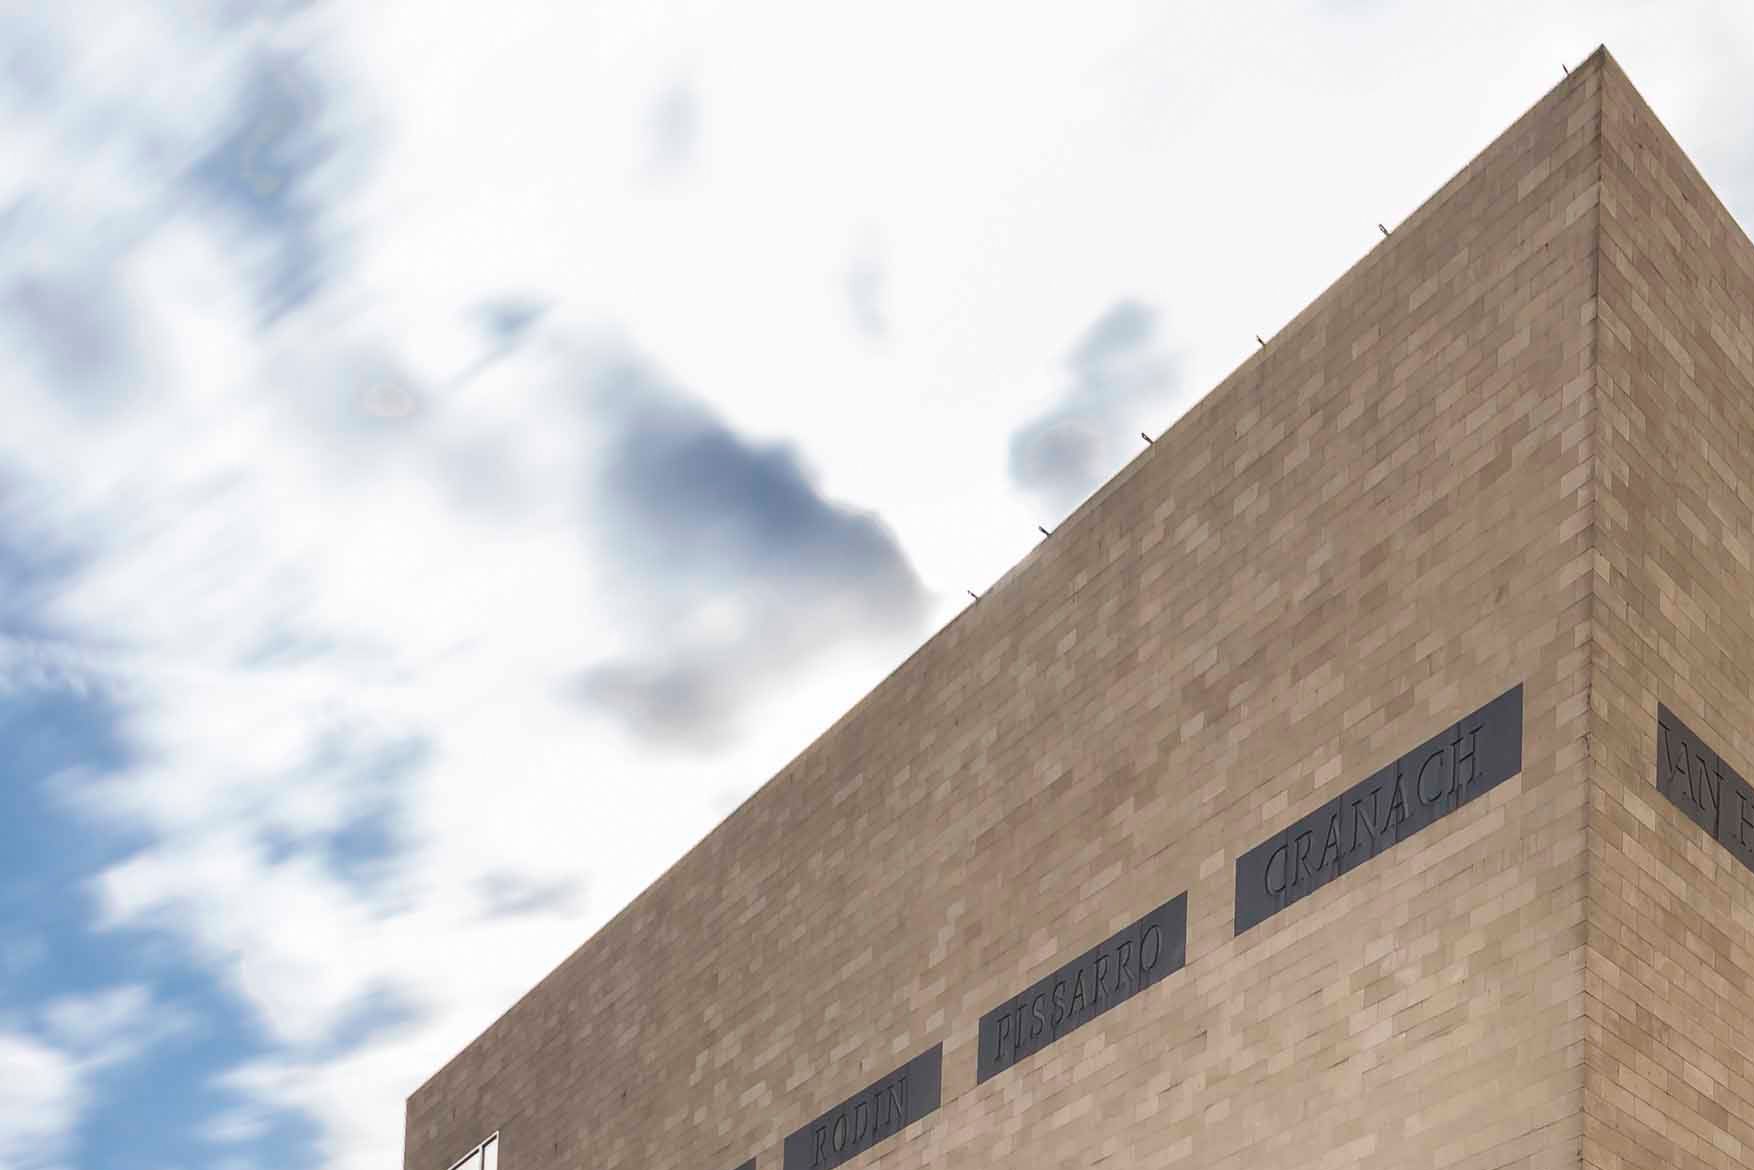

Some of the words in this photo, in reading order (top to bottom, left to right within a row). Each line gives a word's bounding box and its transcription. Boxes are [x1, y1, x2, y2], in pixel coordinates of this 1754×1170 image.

[1263, 723, 1484, 896] CRANACH
[1658, 719, 1724, 816] VAN
[994, 924, 1161, 1062] PISSARRO
[811, 1075, 908, 1168] RODIN
